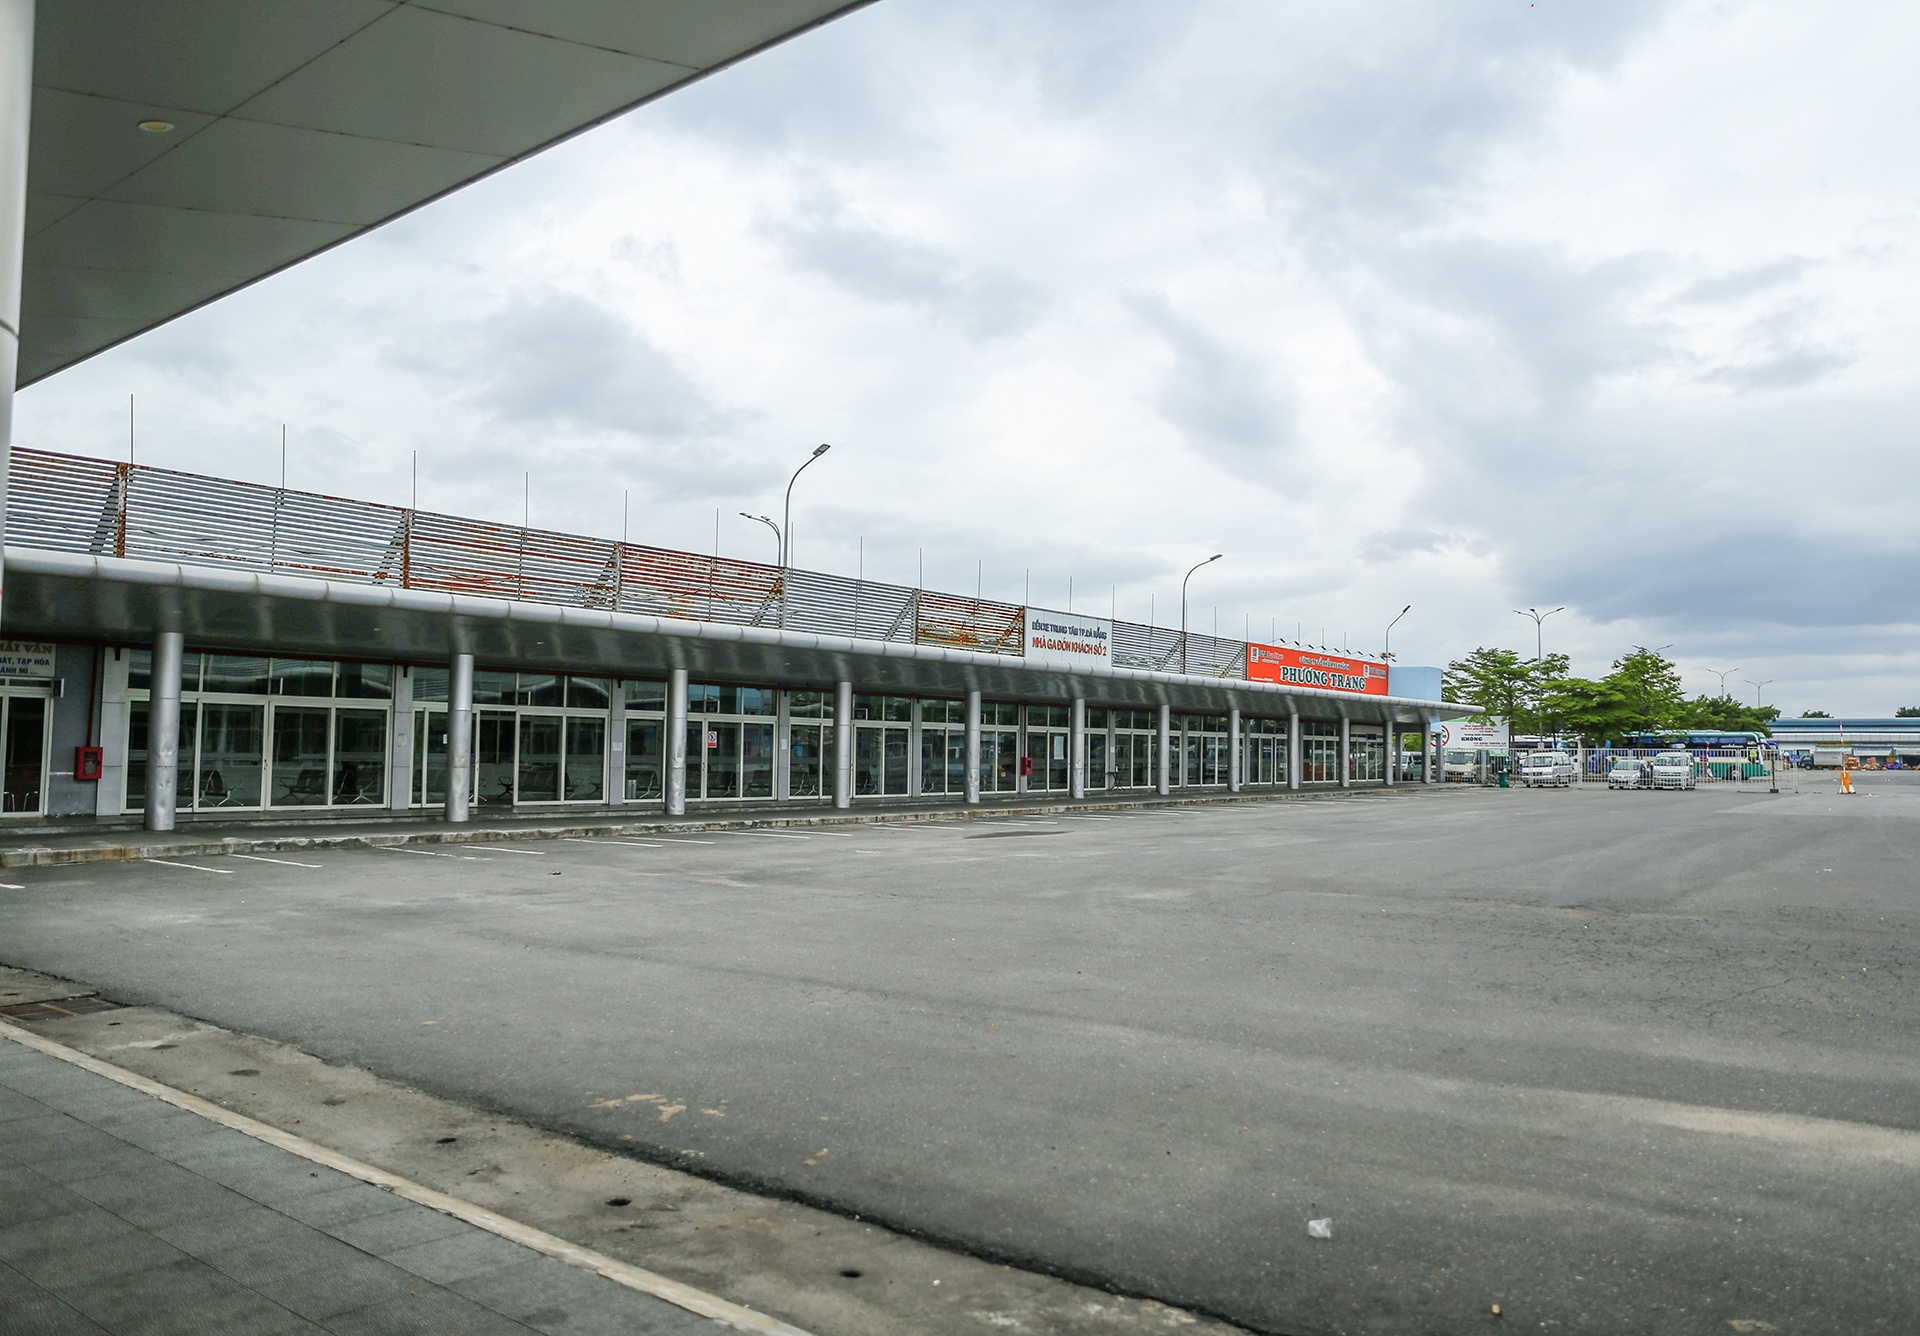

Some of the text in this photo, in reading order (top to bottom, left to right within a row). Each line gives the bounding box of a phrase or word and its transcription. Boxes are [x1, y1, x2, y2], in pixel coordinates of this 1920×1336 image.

[1050, 624, 1067, 634] TRUNG
[1032, 635, 1107, 656] NHÀ GA ĐÓN KHÁCH SỐ 2
[17, 657, 32, 666] TẠP
[34, 657, 50, 666] HÓA
[19, 666, 28, 674] MÌ
[1280, 666, 1366, 691] PHƯƠNG TRANG
